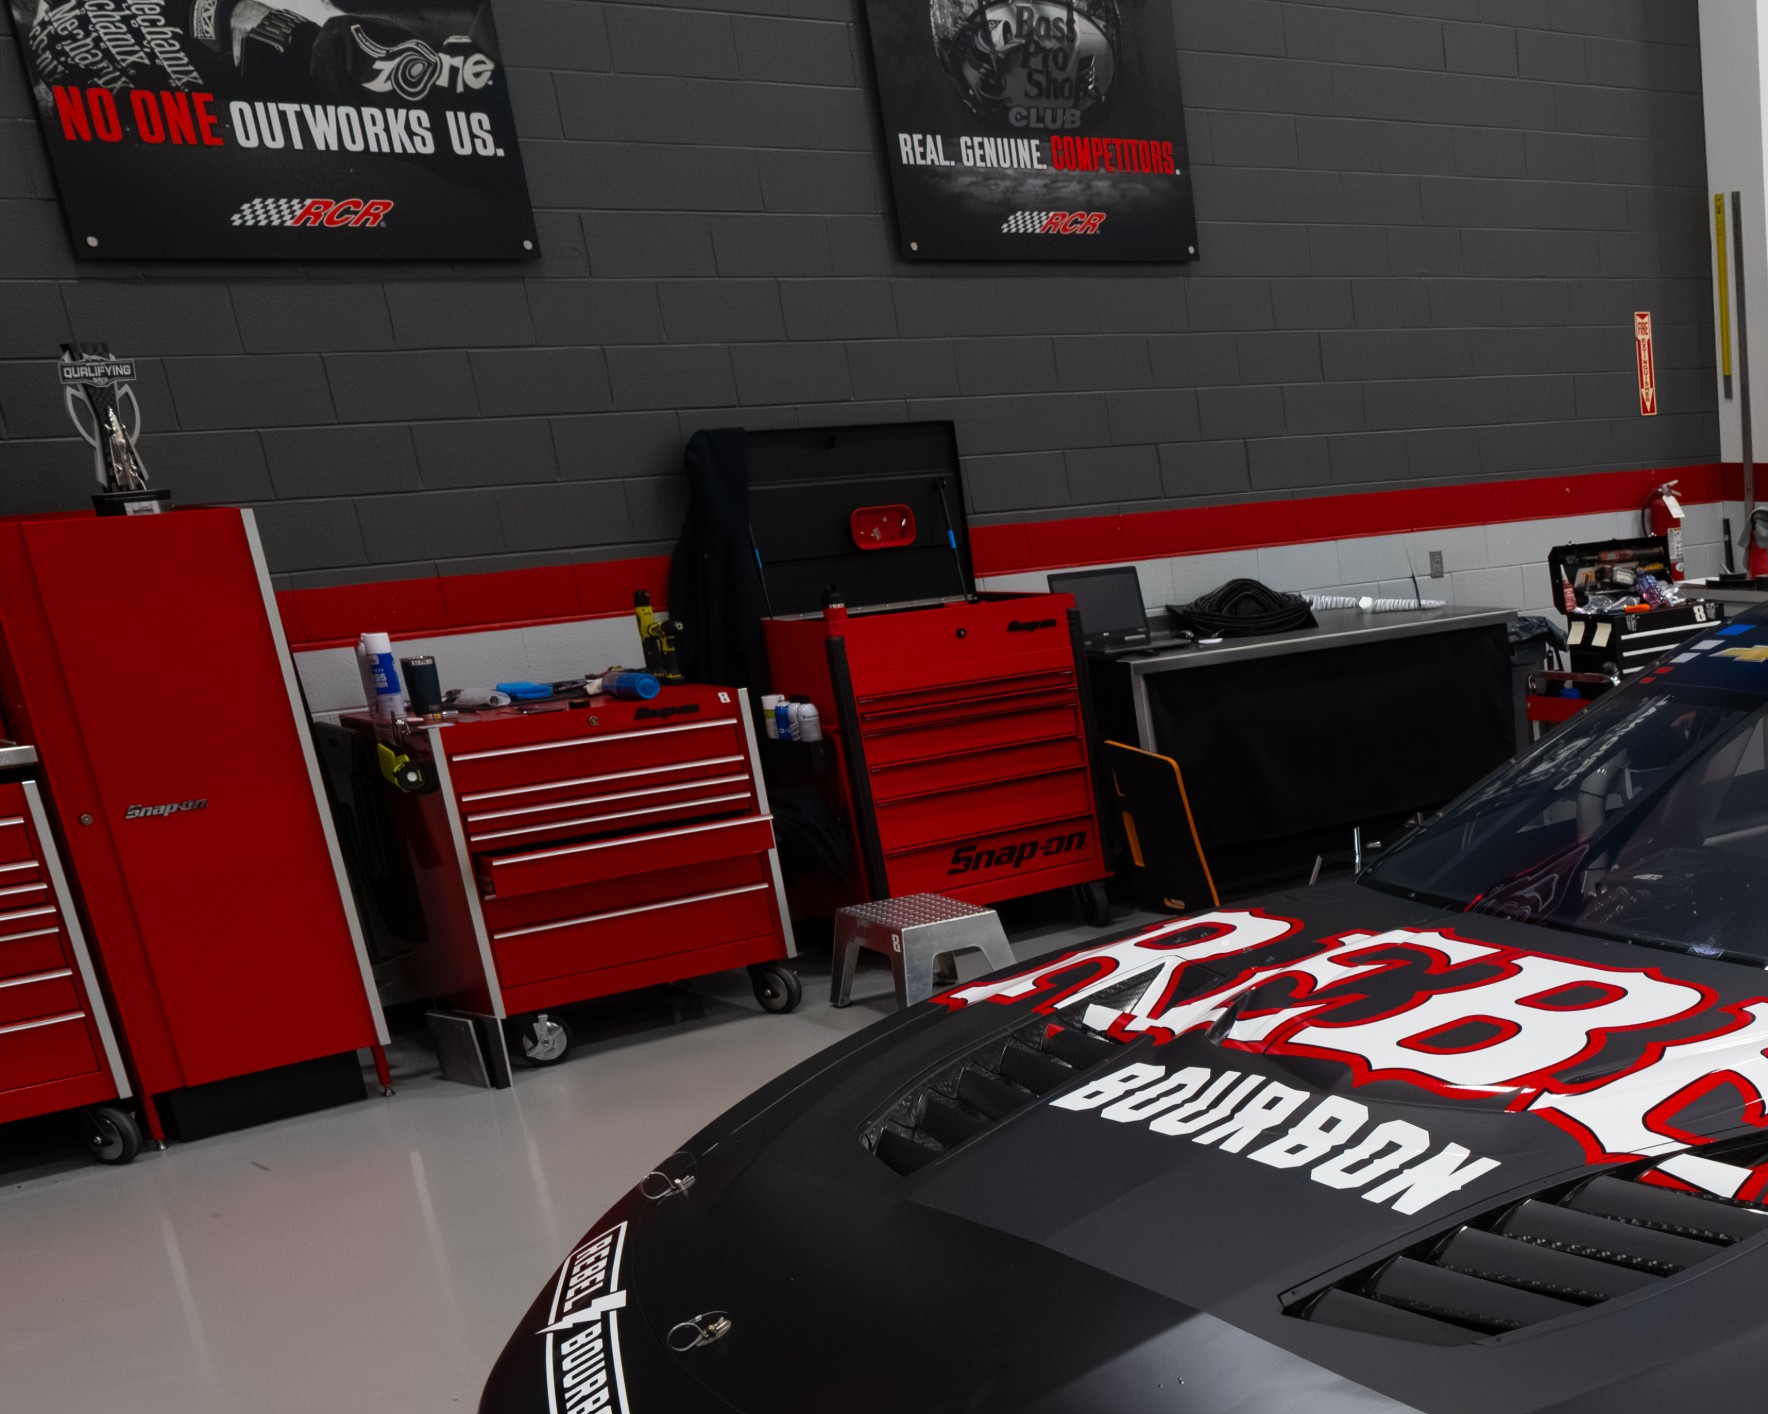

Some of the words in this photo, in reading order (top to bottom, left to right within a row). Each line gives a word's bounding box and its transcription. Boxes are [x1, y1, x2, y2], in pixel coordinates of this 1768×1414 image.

[52, 85, 123, 143] NO
[130, 89, 225, 147] ONE
[229, 100, 436, 155] OUTWORKS
[445, 110, 506, 157] US.
[1008, 105, 1082, 129] CLUB
[898, 132, 956, 167] REAL.
[959, 135, 1048, 170] GENUINE.
[1050, 134, 1181, 175] COMPETITORS.
[290, 198, 394, 228] RCR
[1038, 210, 1107, 235] RCR
[62, 363, 132, 379] QUALIFYING
[1692, 604, 1708, 623] 8
[124, 798, 209, 820] Snap-on
[946, 830, 1087, 877] Snap-on
[1049, 1062, 1501, 1216] BOURBON
[562, 1233, 614, 1323] REBEL
